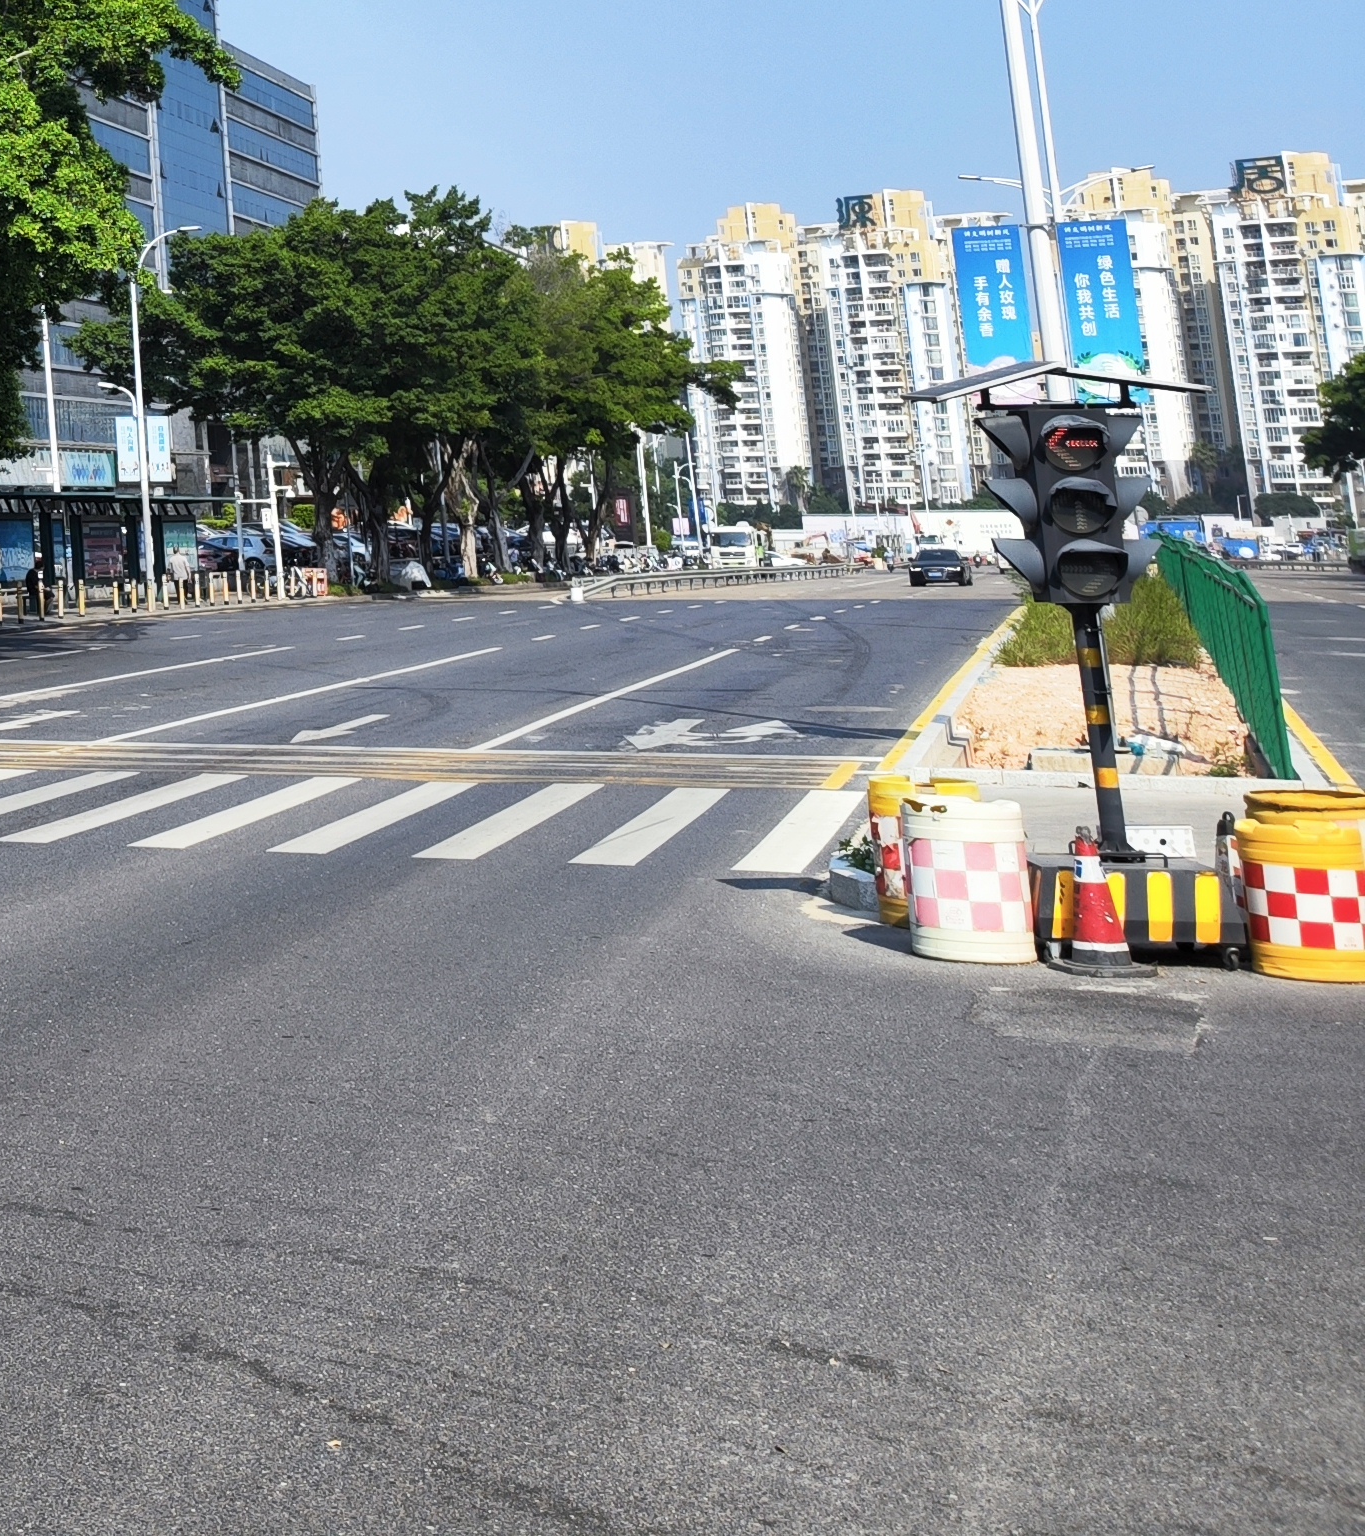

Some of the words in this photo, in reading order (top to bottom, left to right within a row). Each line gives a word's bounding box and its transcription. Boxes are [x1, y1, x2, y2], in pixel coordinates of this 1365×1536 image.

[973, 275, 994, 338] 手有余香
[994, 258, 1017, 321] 赠人玫瑰
[1073, 272, 1097, 337] 你我共创
[1096, 254, 1121, 319] 绿色生活
